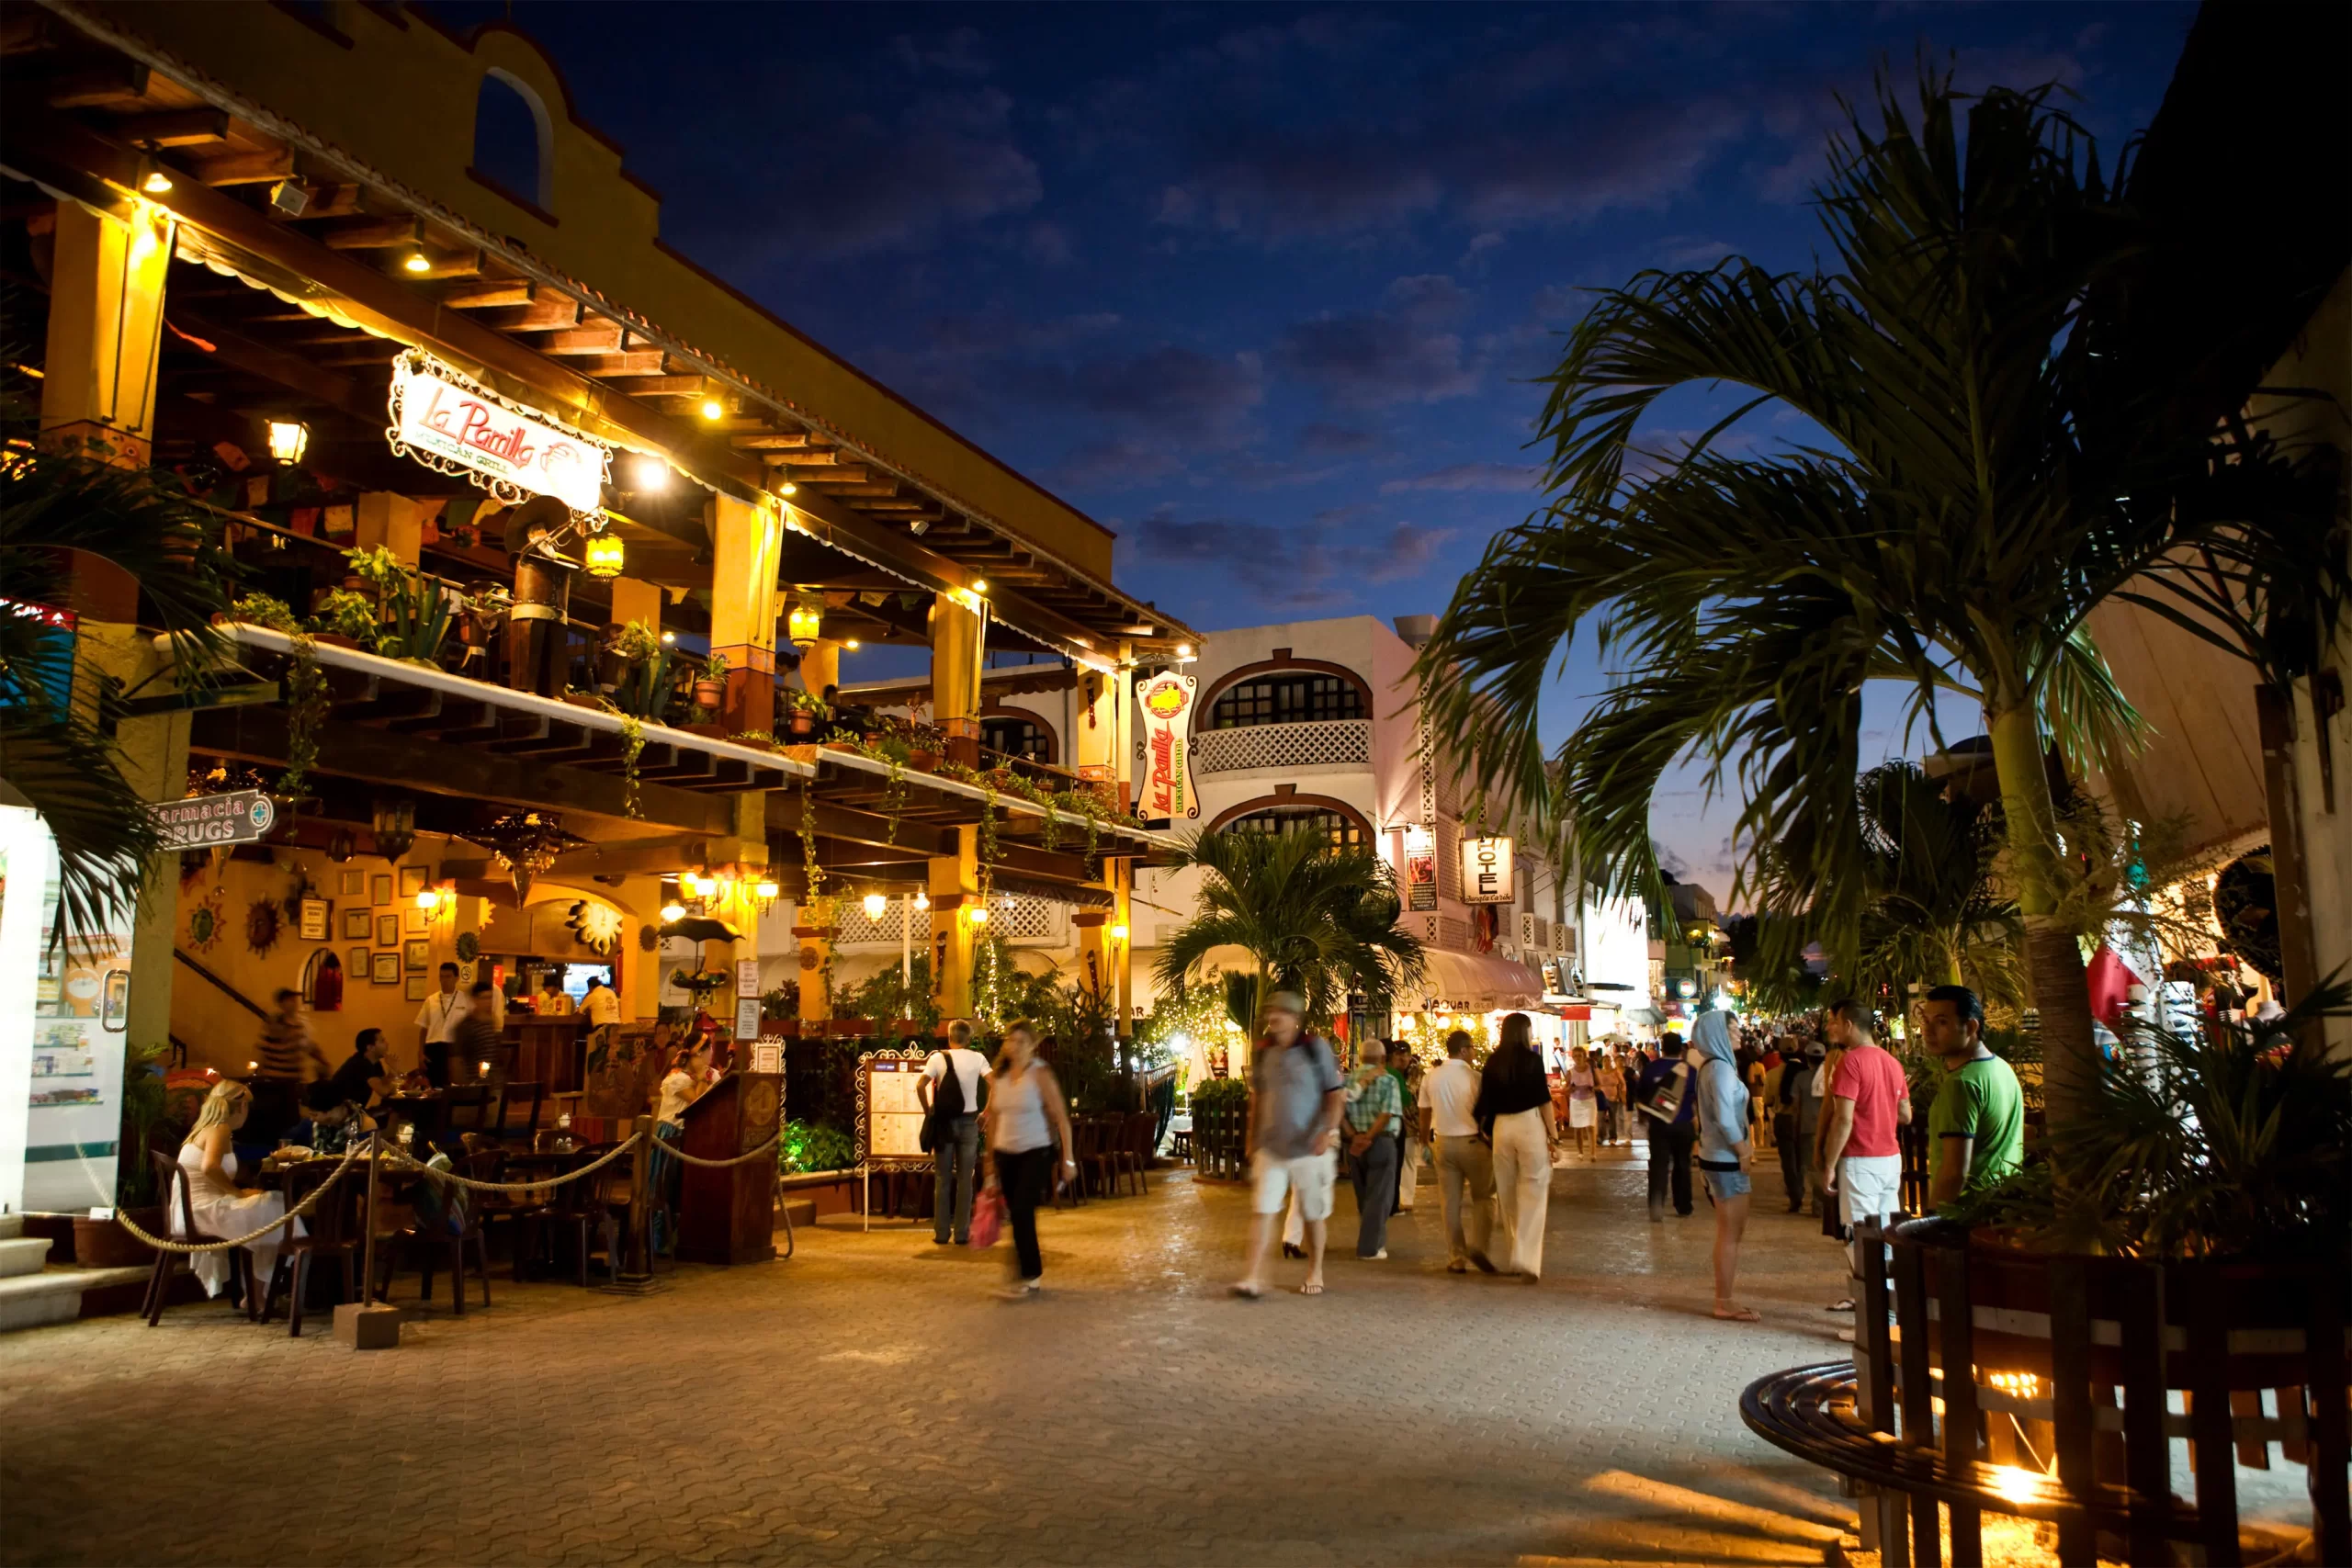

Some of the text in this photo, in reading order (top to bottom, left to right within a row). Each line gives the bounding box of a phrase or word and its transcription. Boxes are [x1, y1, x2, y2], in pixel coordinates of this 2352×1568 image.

[419, 386, 536, 467] La Parrilla
[476, 455, 509, 475] GRILL
[1150, 726, 1178, 815] La Parrilla
[1175, 738, 1184, 814] MEXICAN GRILL
[1476, 837, 1498, 895] HOTEL
